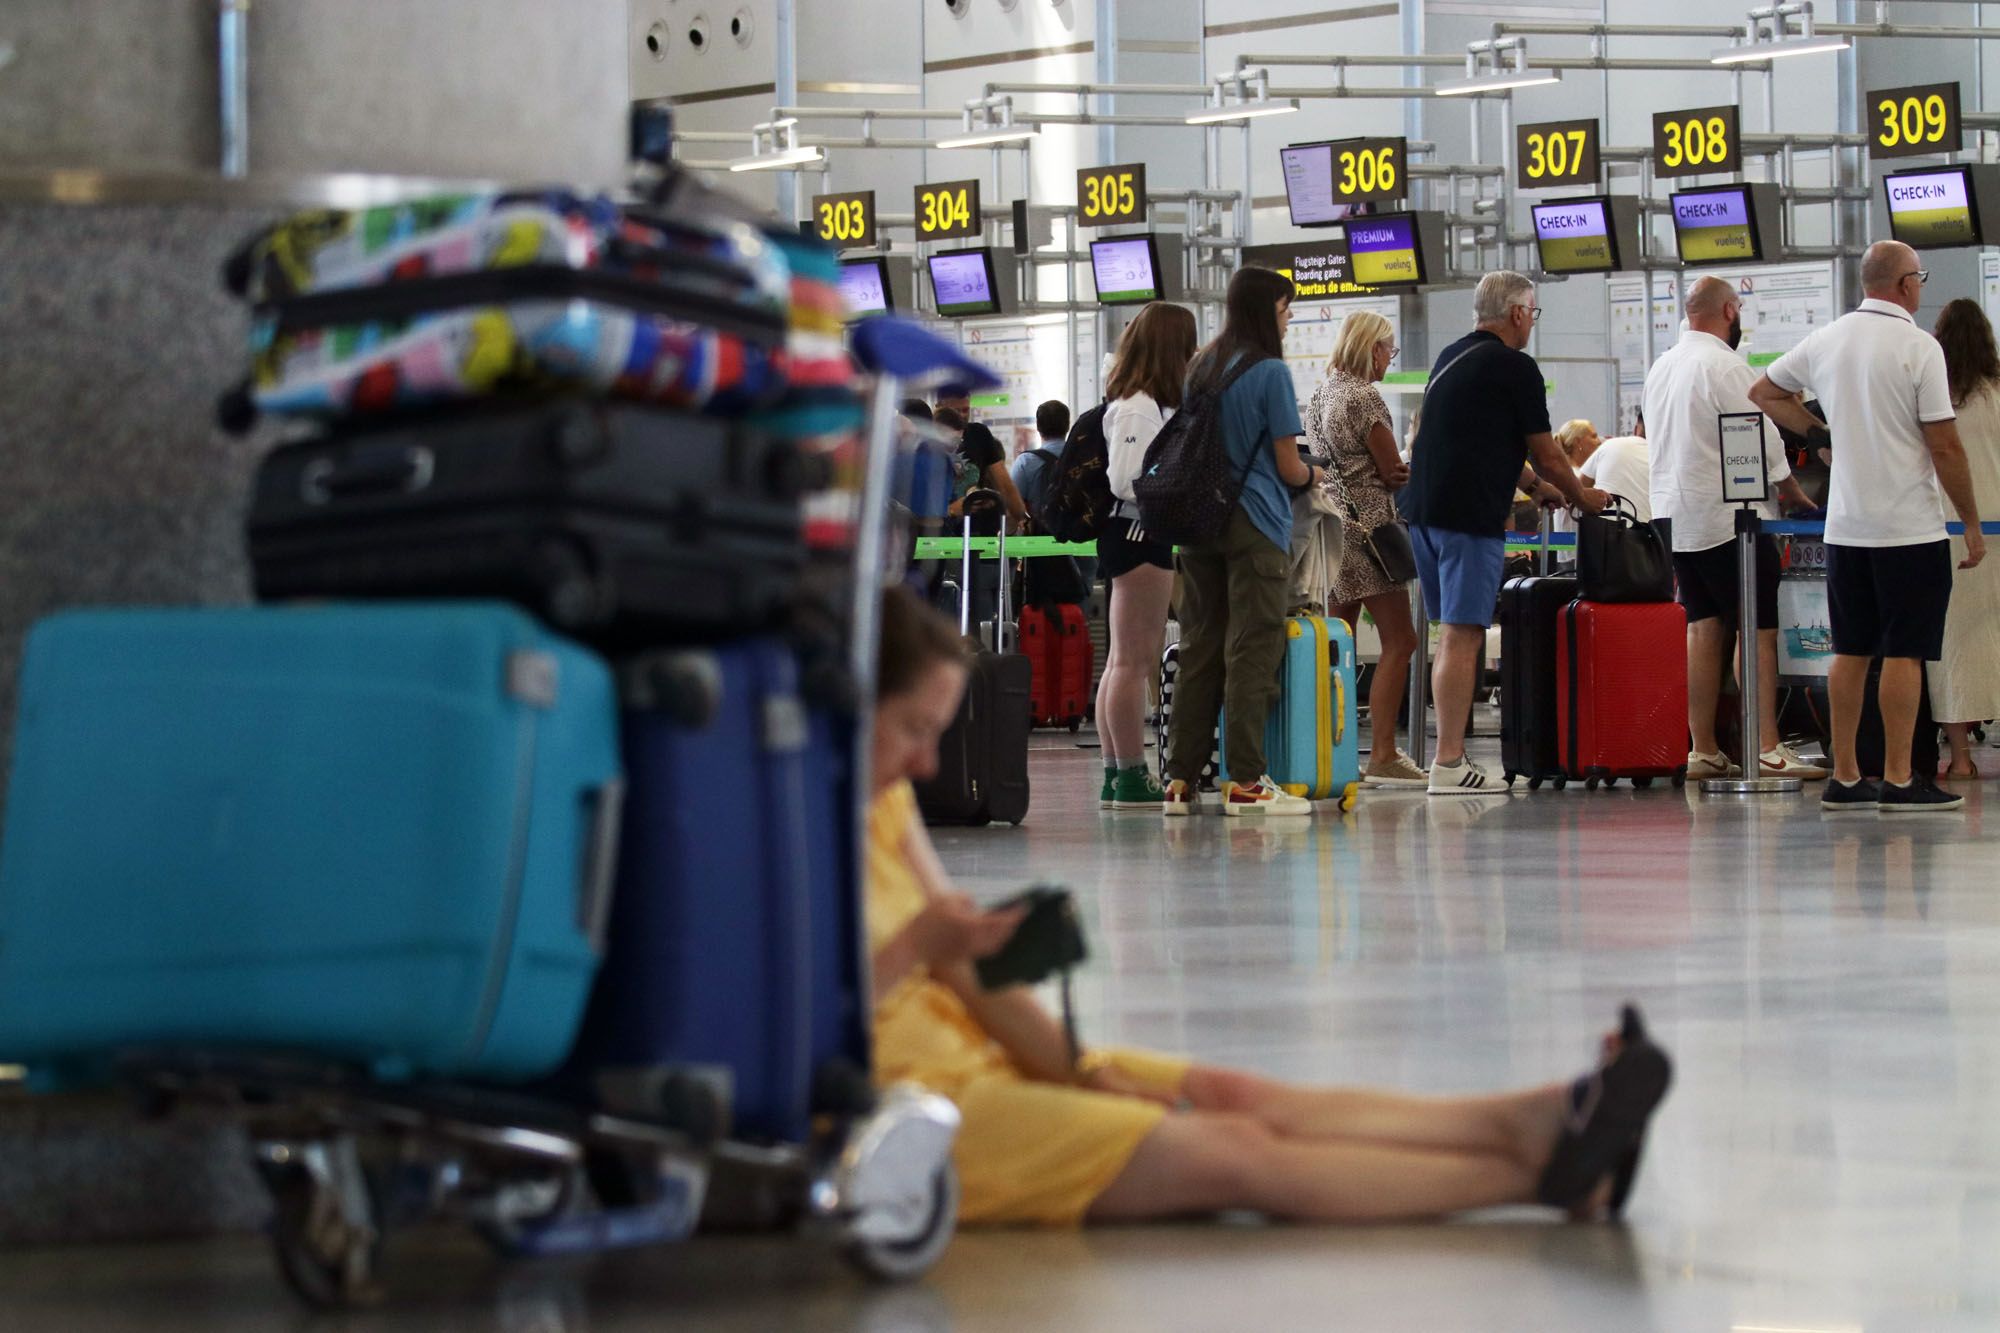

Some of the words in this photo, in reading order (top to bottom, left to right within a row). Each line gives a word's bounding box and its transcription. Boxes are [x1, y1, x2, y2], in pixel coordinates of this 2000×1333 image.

[1878, 94, 1947, 147] 309
[1663, 117, 1727, 167] 308
[1526, 130, 1586, 178] 307
[1338, 147, 1395, 195] 306
[1084, 173, 1135, 218] 305
[1893, 184, 1946, 201] CHECK-IN
[921, 188, 970, 233] 304
[1679, 202, 1728, 218] CHECK-IN
[819, 199, 865, 241] 303
[1540, 214, 1588, 230] CHECK-IN
[1351, 229, 1395, 245] PREMIUM
[1714, 232, 1746, 249] vueling
[1575, 243, 1605, 258] vueling
[1295, 256, 1326, 269] Flugsteige
[1328, 254, 1346, 265] Gates
[1384, 257, 1412, 273] vueling
[1295, 269, 1323, 281] Boarding
[1324, 268, 1342, 281] gates
[1296, 283, 1326, 296] Puertas
[1328, 281, 1339, 293] de
[1726, 456, 1760, 466] CHECK-IN
